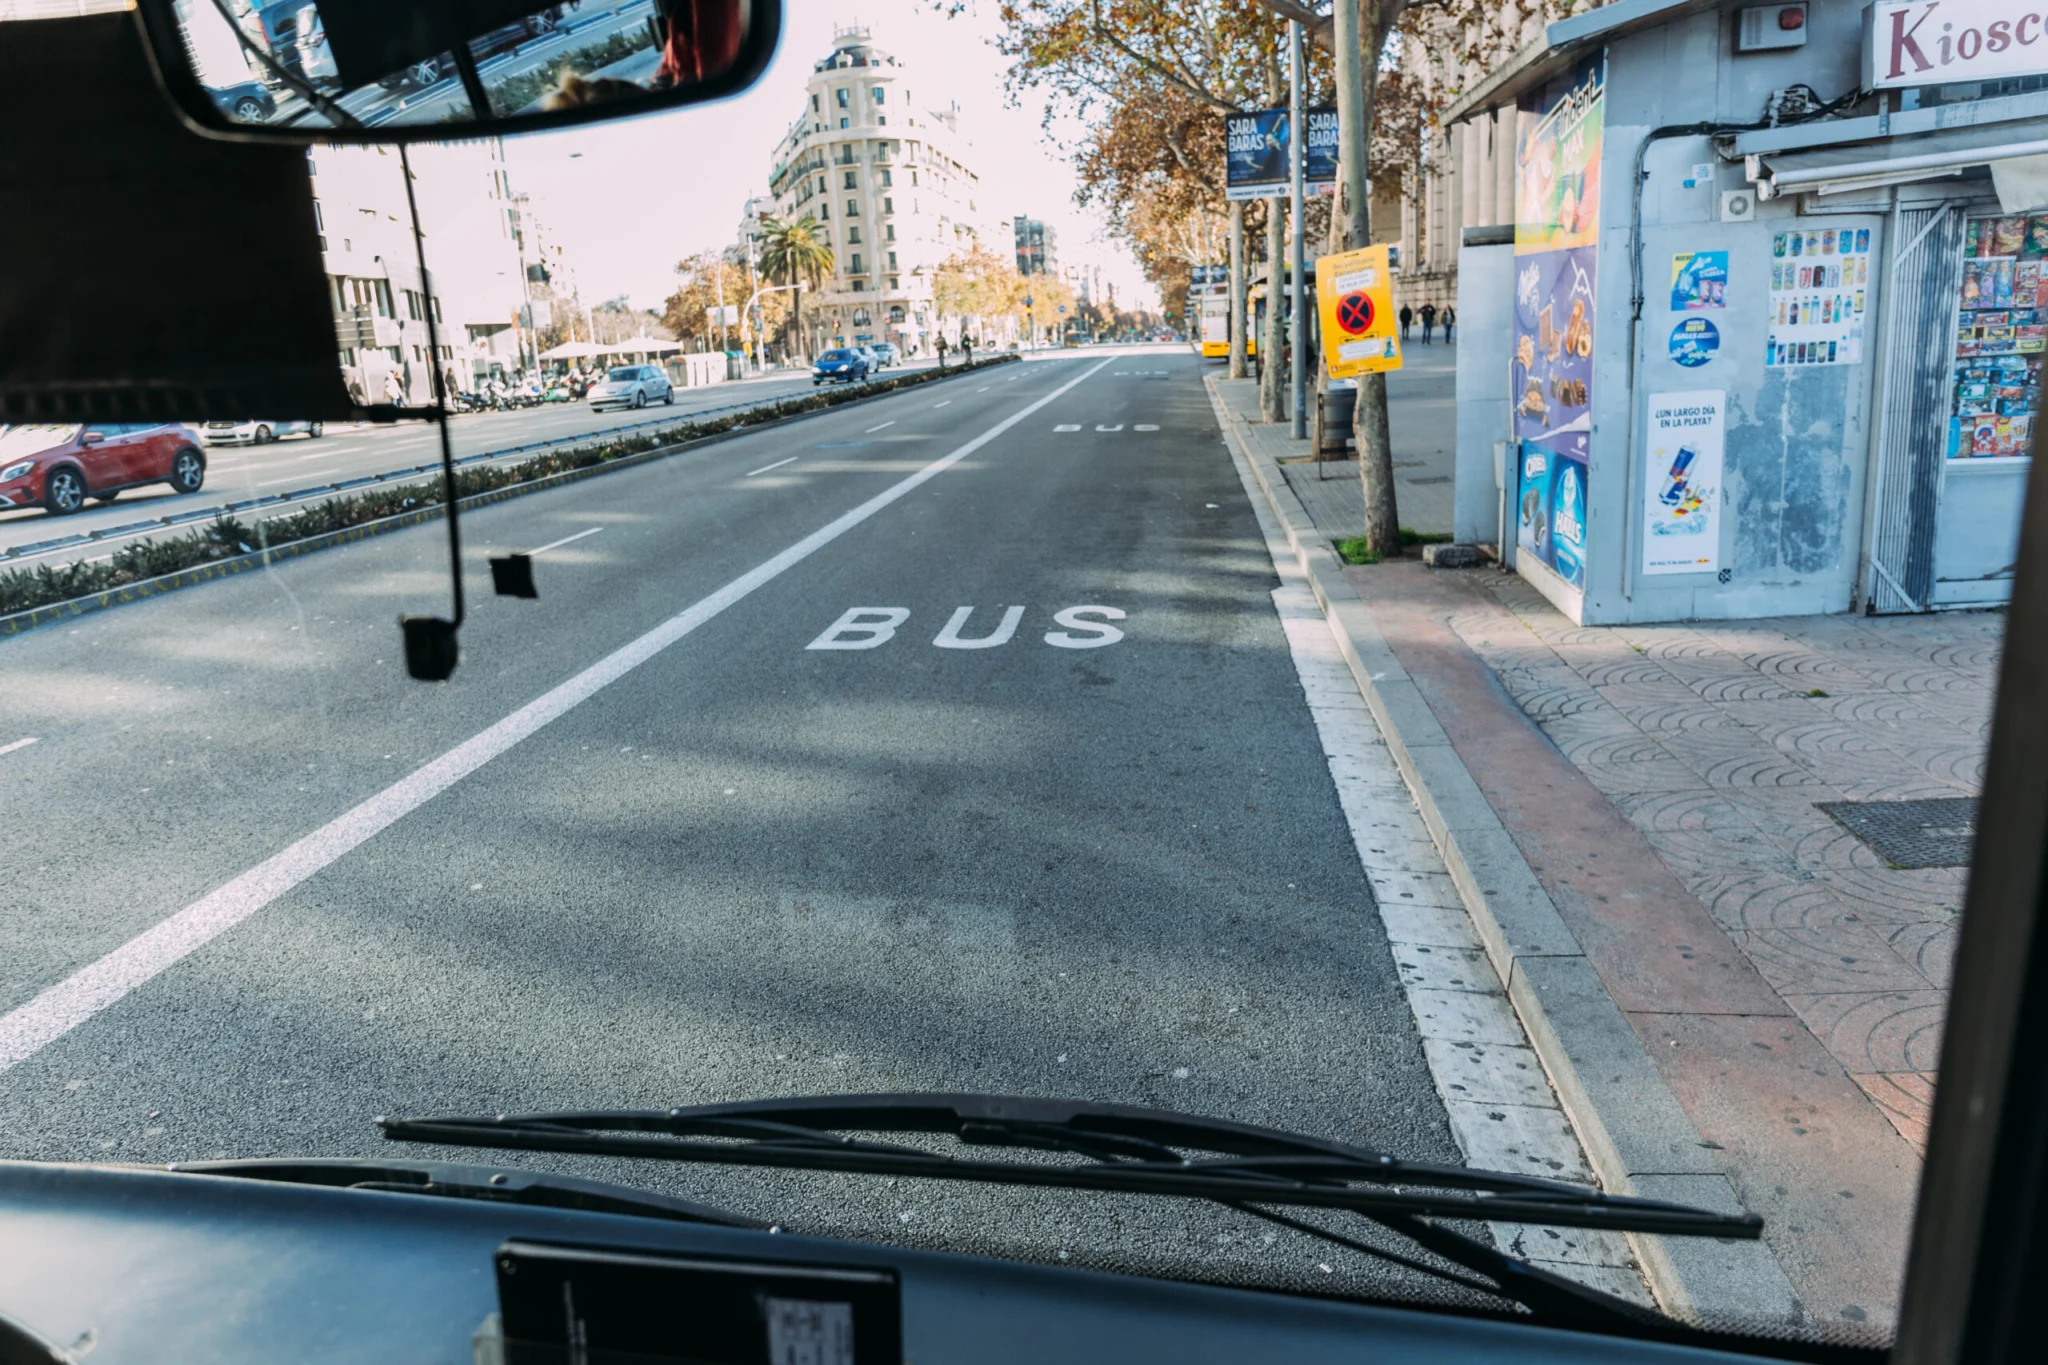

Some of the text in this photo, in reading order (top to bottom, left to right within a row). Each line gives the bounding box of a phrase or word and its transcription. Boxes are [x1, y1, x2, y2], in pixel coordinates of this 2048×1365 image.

[1885, 1, 2048, 80] Kiosc
[1228, 118, 1258, 136] SARA
[1309, 114, 1338, 131] SARA
[1228, 134, 1265, 152] BARAS
[1562, 125, 1585, 168] MAX
[1655, 404, 1716, 419] ¿UN LARGO DÍA
[1660, 416, 1712, 428] EN LA PLAYA?
[1554, 510, 1582, 545] HALLS
[804, 605, 1127, 650] BUS
